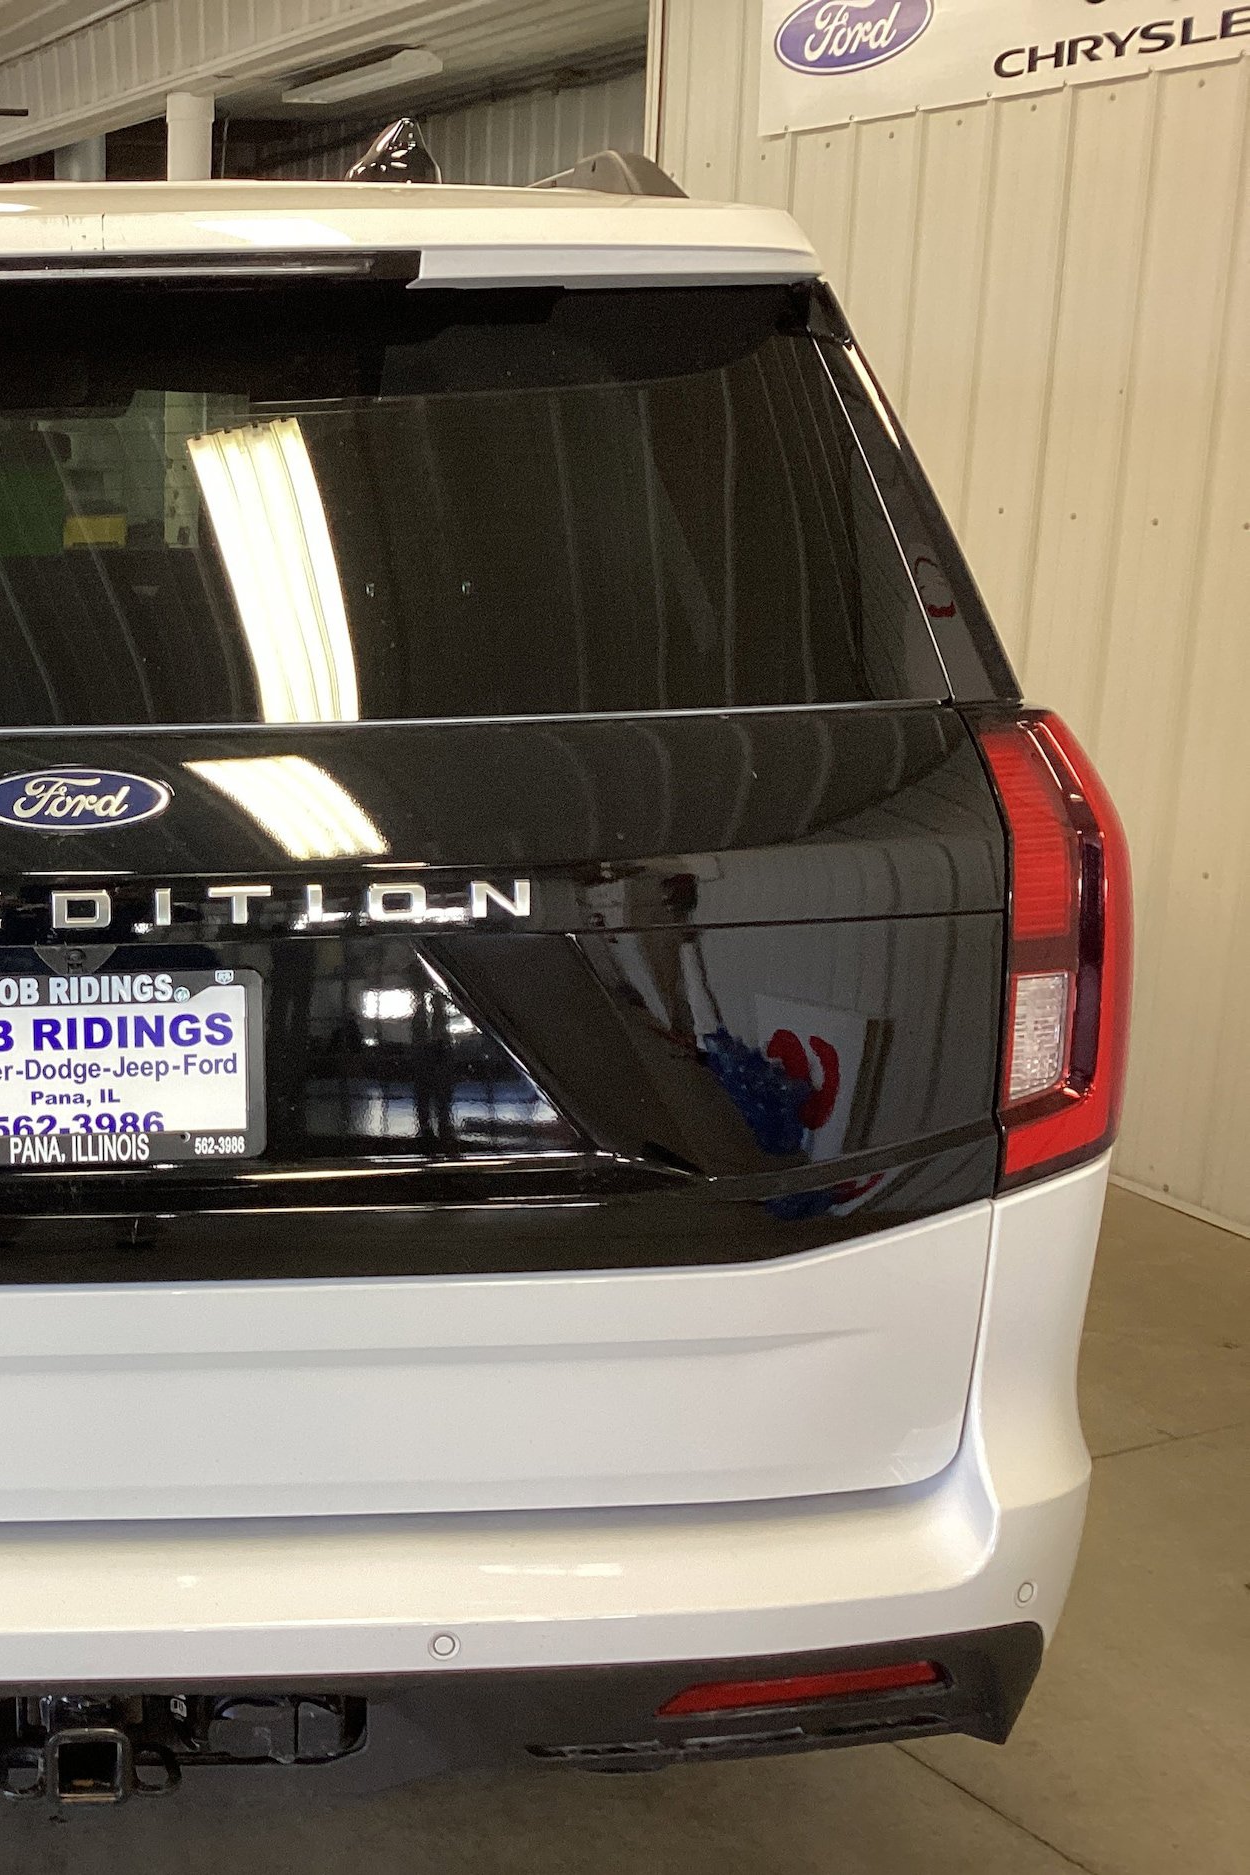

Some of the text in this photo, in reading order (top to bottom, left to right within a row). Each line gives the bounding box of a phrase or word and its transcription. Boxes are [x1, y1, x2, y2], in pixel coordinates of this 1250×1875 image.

[804, 0, 900, 61] Ford
[12, 776, 131, 818] Ford
[48, 973, 174, 1004] RIDINGS
[32, 1011, 235, 1051] RIDINGS
[30, 1088, 121, 1108] Pana, IL
[9, 1133, 150, 1164] PANA, ILLINOIS
[194, 1135, 246, 1155] 562-3986
